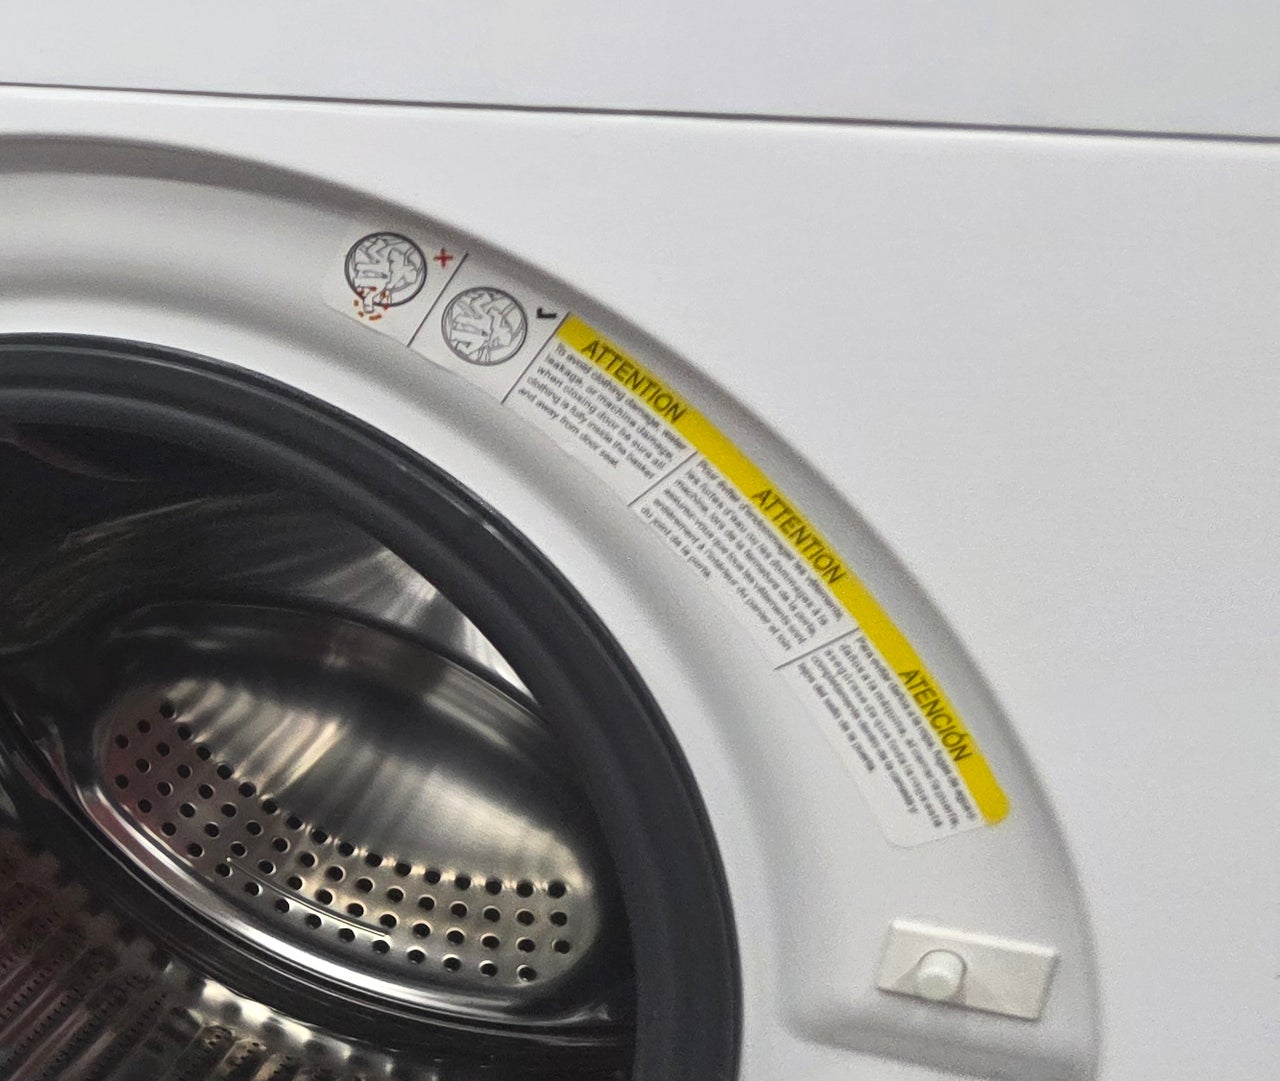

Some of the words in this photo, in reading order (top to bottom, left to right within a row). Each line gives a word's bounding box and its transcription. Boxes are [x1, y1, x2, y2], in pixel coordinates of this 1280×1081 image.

[581, 340, 687, 423] ATTENTION
[750, 488, 847, 584] ATTENTION
[898, 669, 973, 762] ATENCIÓN
